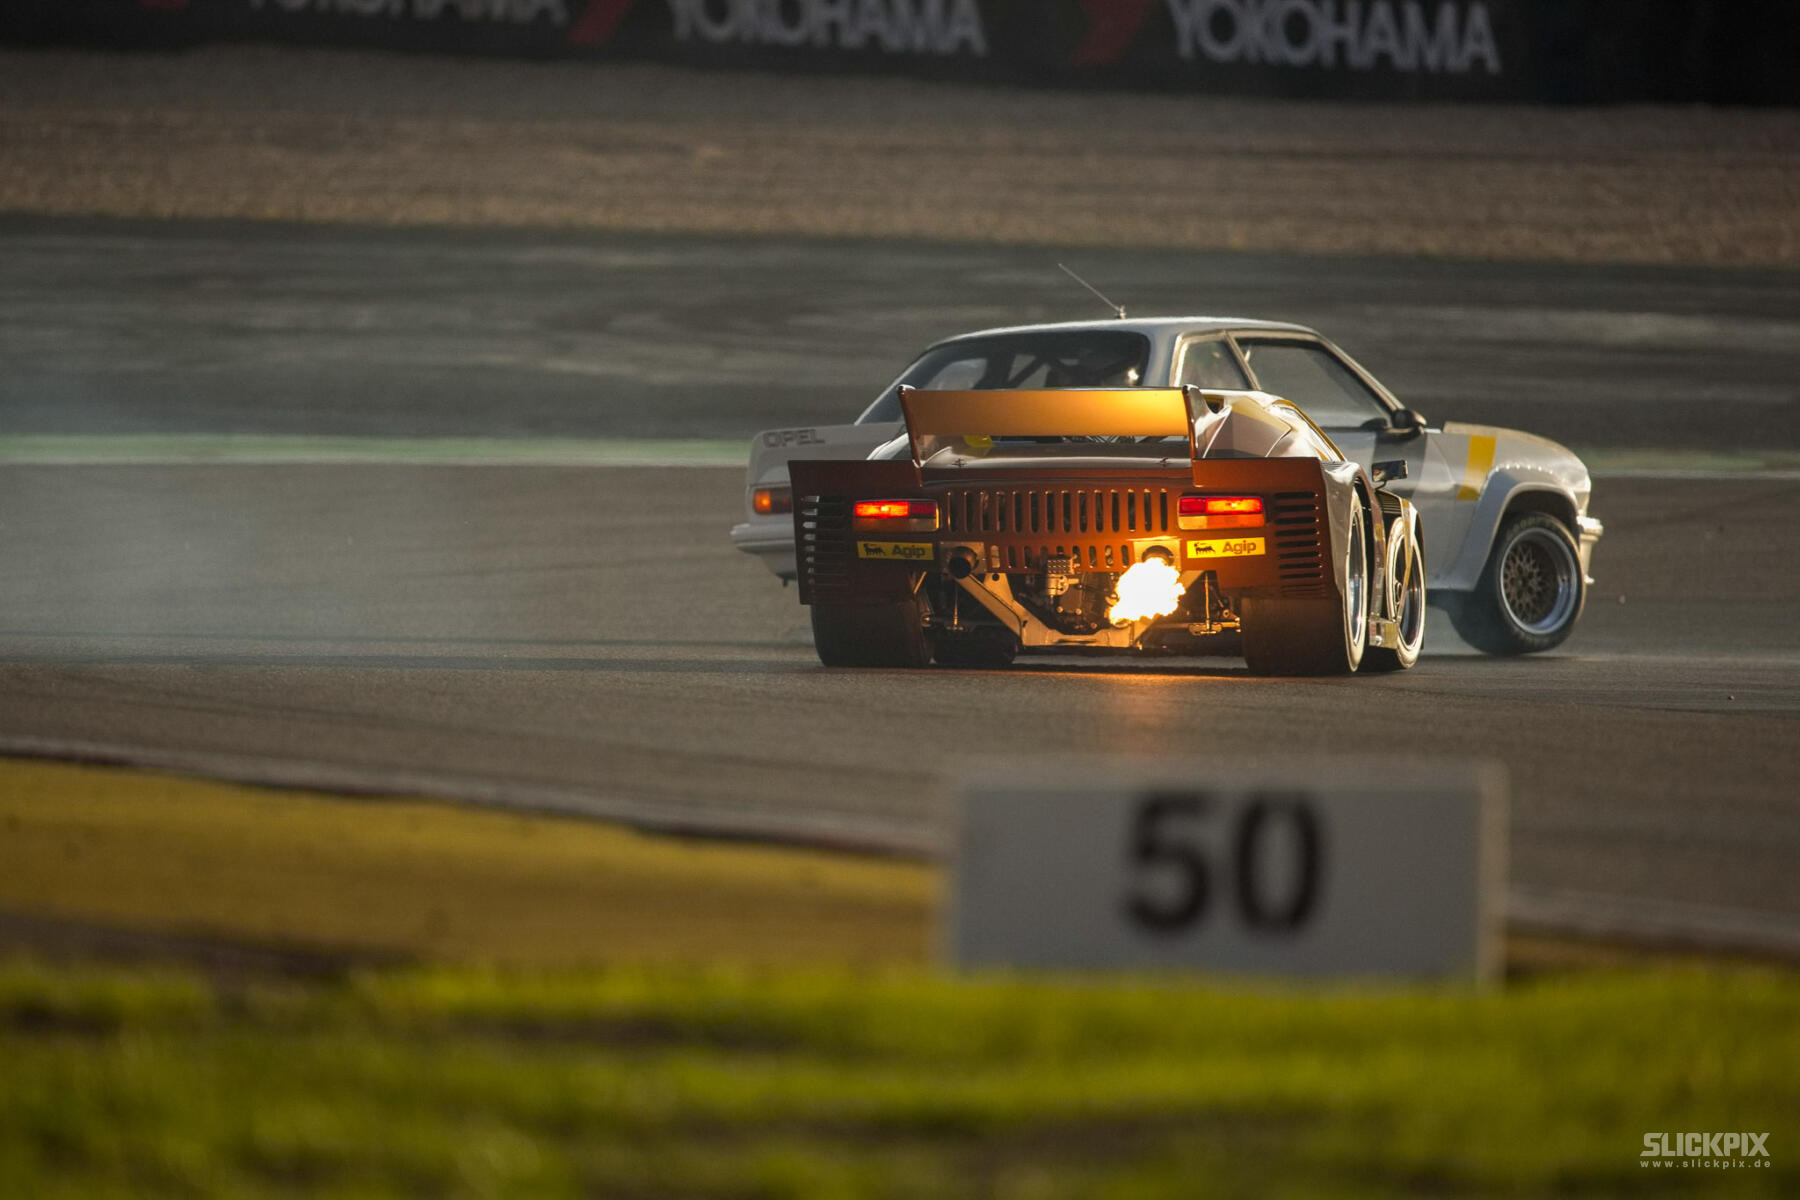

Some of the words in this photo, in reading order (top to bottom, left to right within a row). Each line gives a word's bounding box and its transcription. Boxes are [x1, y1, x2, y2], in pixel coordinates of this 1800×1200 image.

[1167, 0, 1501, 73] YOKOHAMA
[763, 429, 825, 449] OPEL
[892, 544, 926, 558] Agip
[1222, 540, 1257, 555] Agip
[1122, 788, 1328, 938] 50
